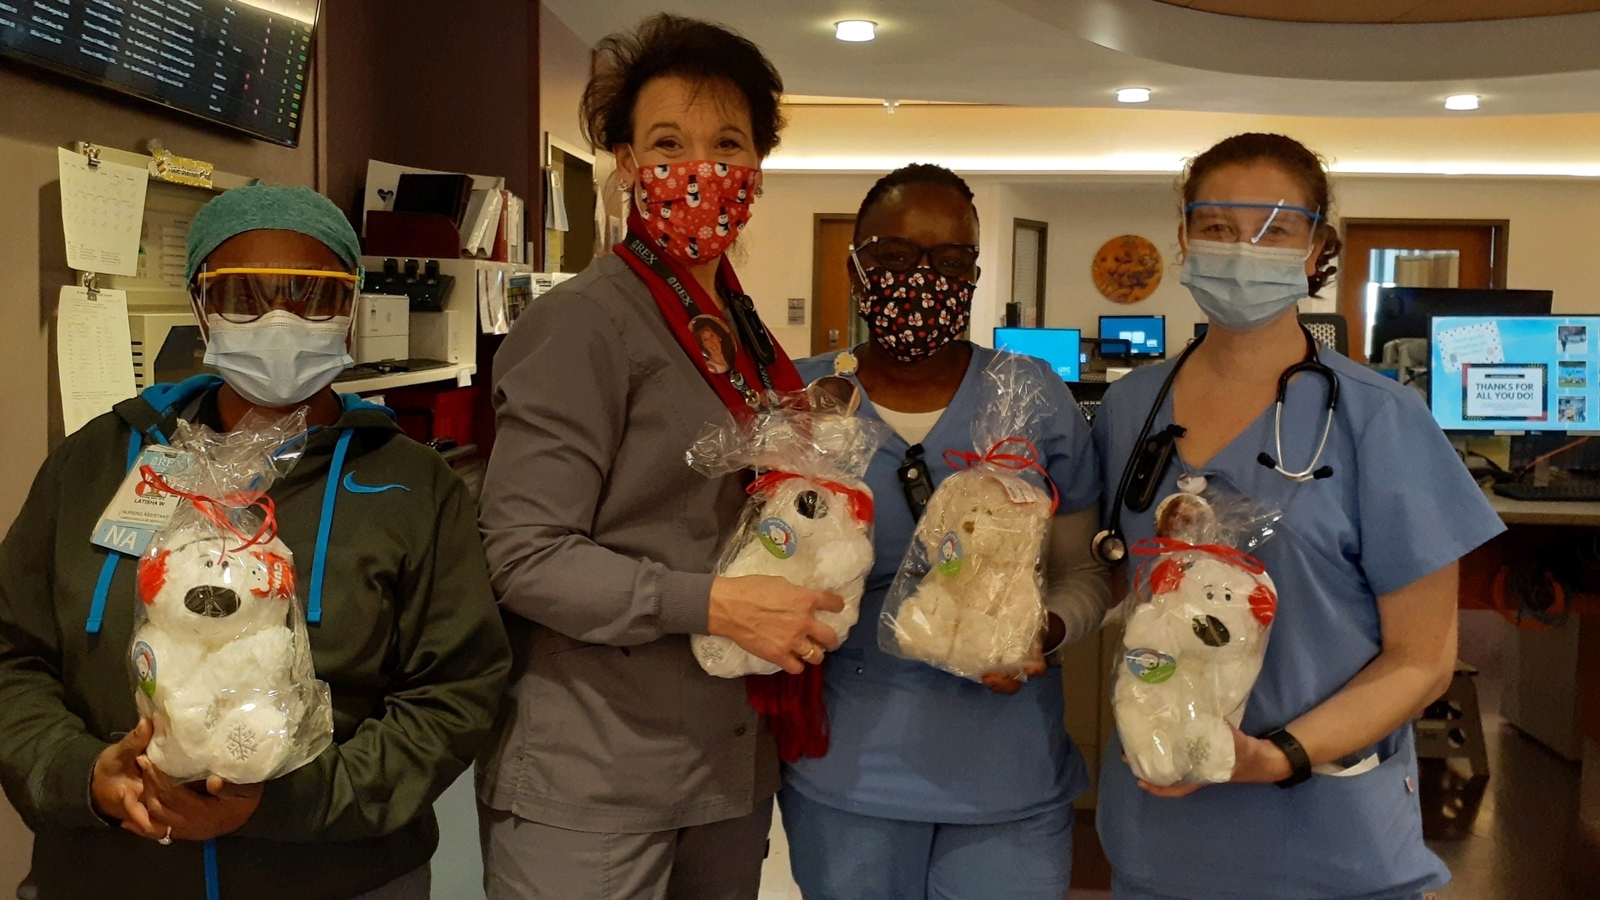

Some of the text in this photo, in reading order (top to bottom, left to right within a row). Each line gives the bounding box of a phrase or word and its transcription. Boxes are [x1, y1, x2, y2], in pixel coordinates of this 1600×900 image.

[636, 243, 658, 264] REX
[672, 282, 693, 307] REX
[1476, 383, 1534, 391] THANKS FOR
[1476, 392, 1534, 400] ALL YOU DO!
[134, 498, 158, 506] LATISHA
[103, 525, 138, 551] NA
